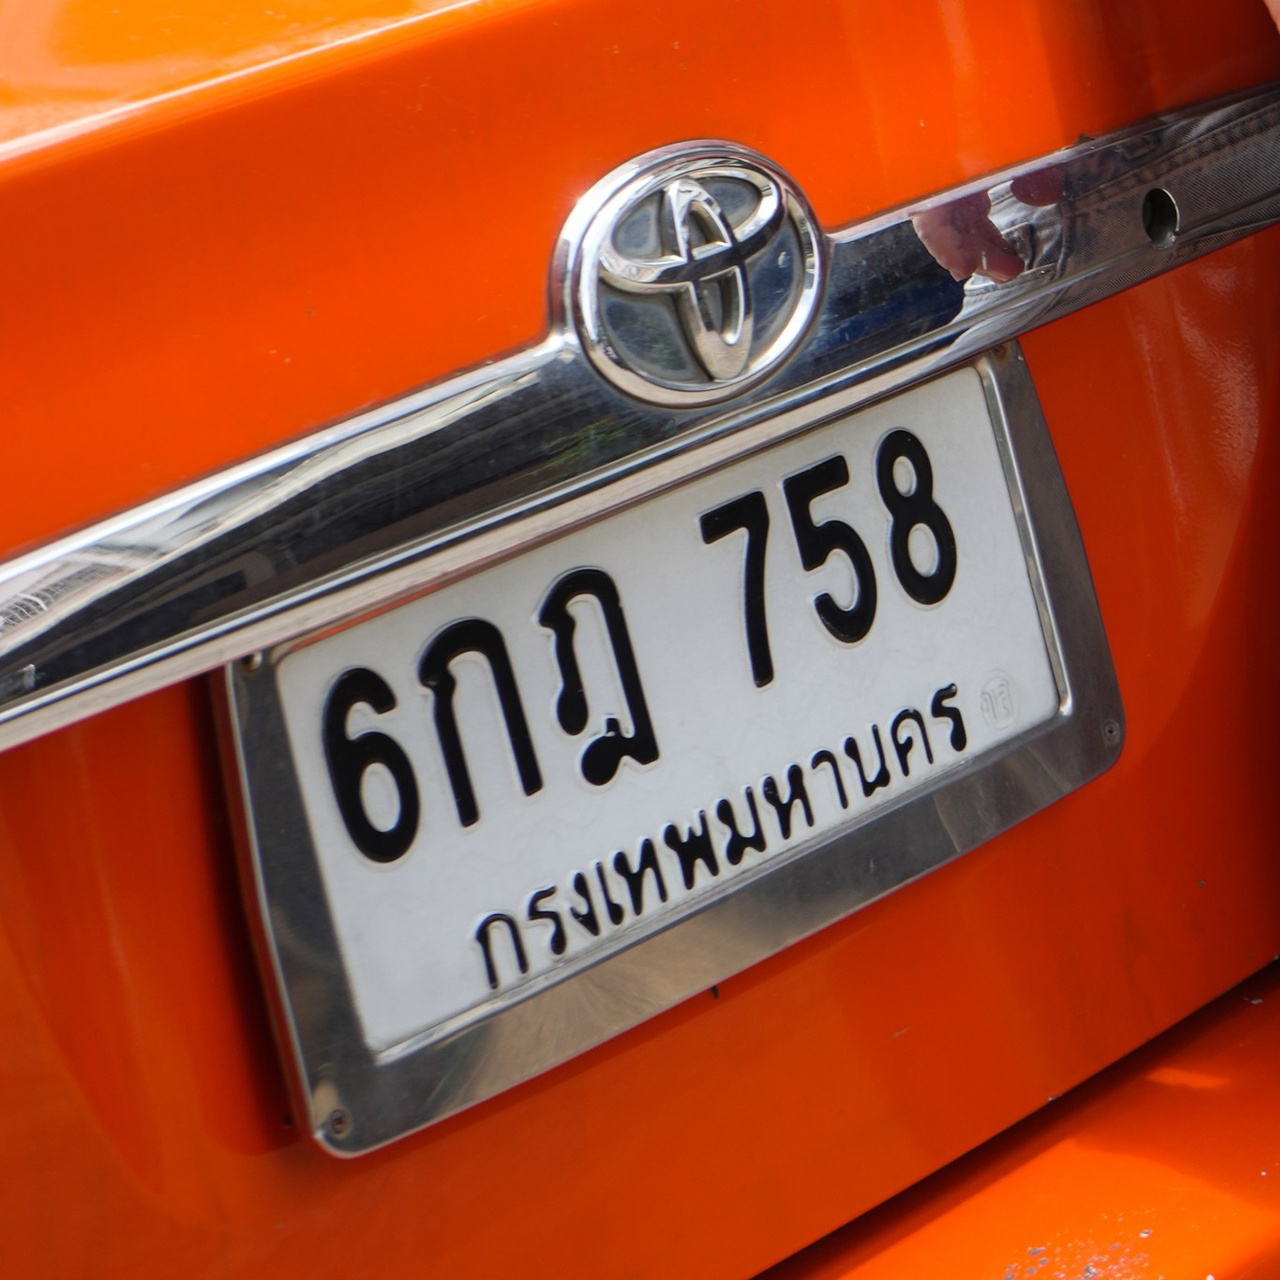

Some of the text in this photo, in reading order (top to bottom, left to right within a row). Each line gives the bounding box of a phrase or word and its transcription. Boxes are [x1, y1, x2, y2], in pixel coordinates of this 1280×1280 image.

[699, 429, 957, 688] 758
[475, 683, 968, 991] กรงเทพมหานคร
